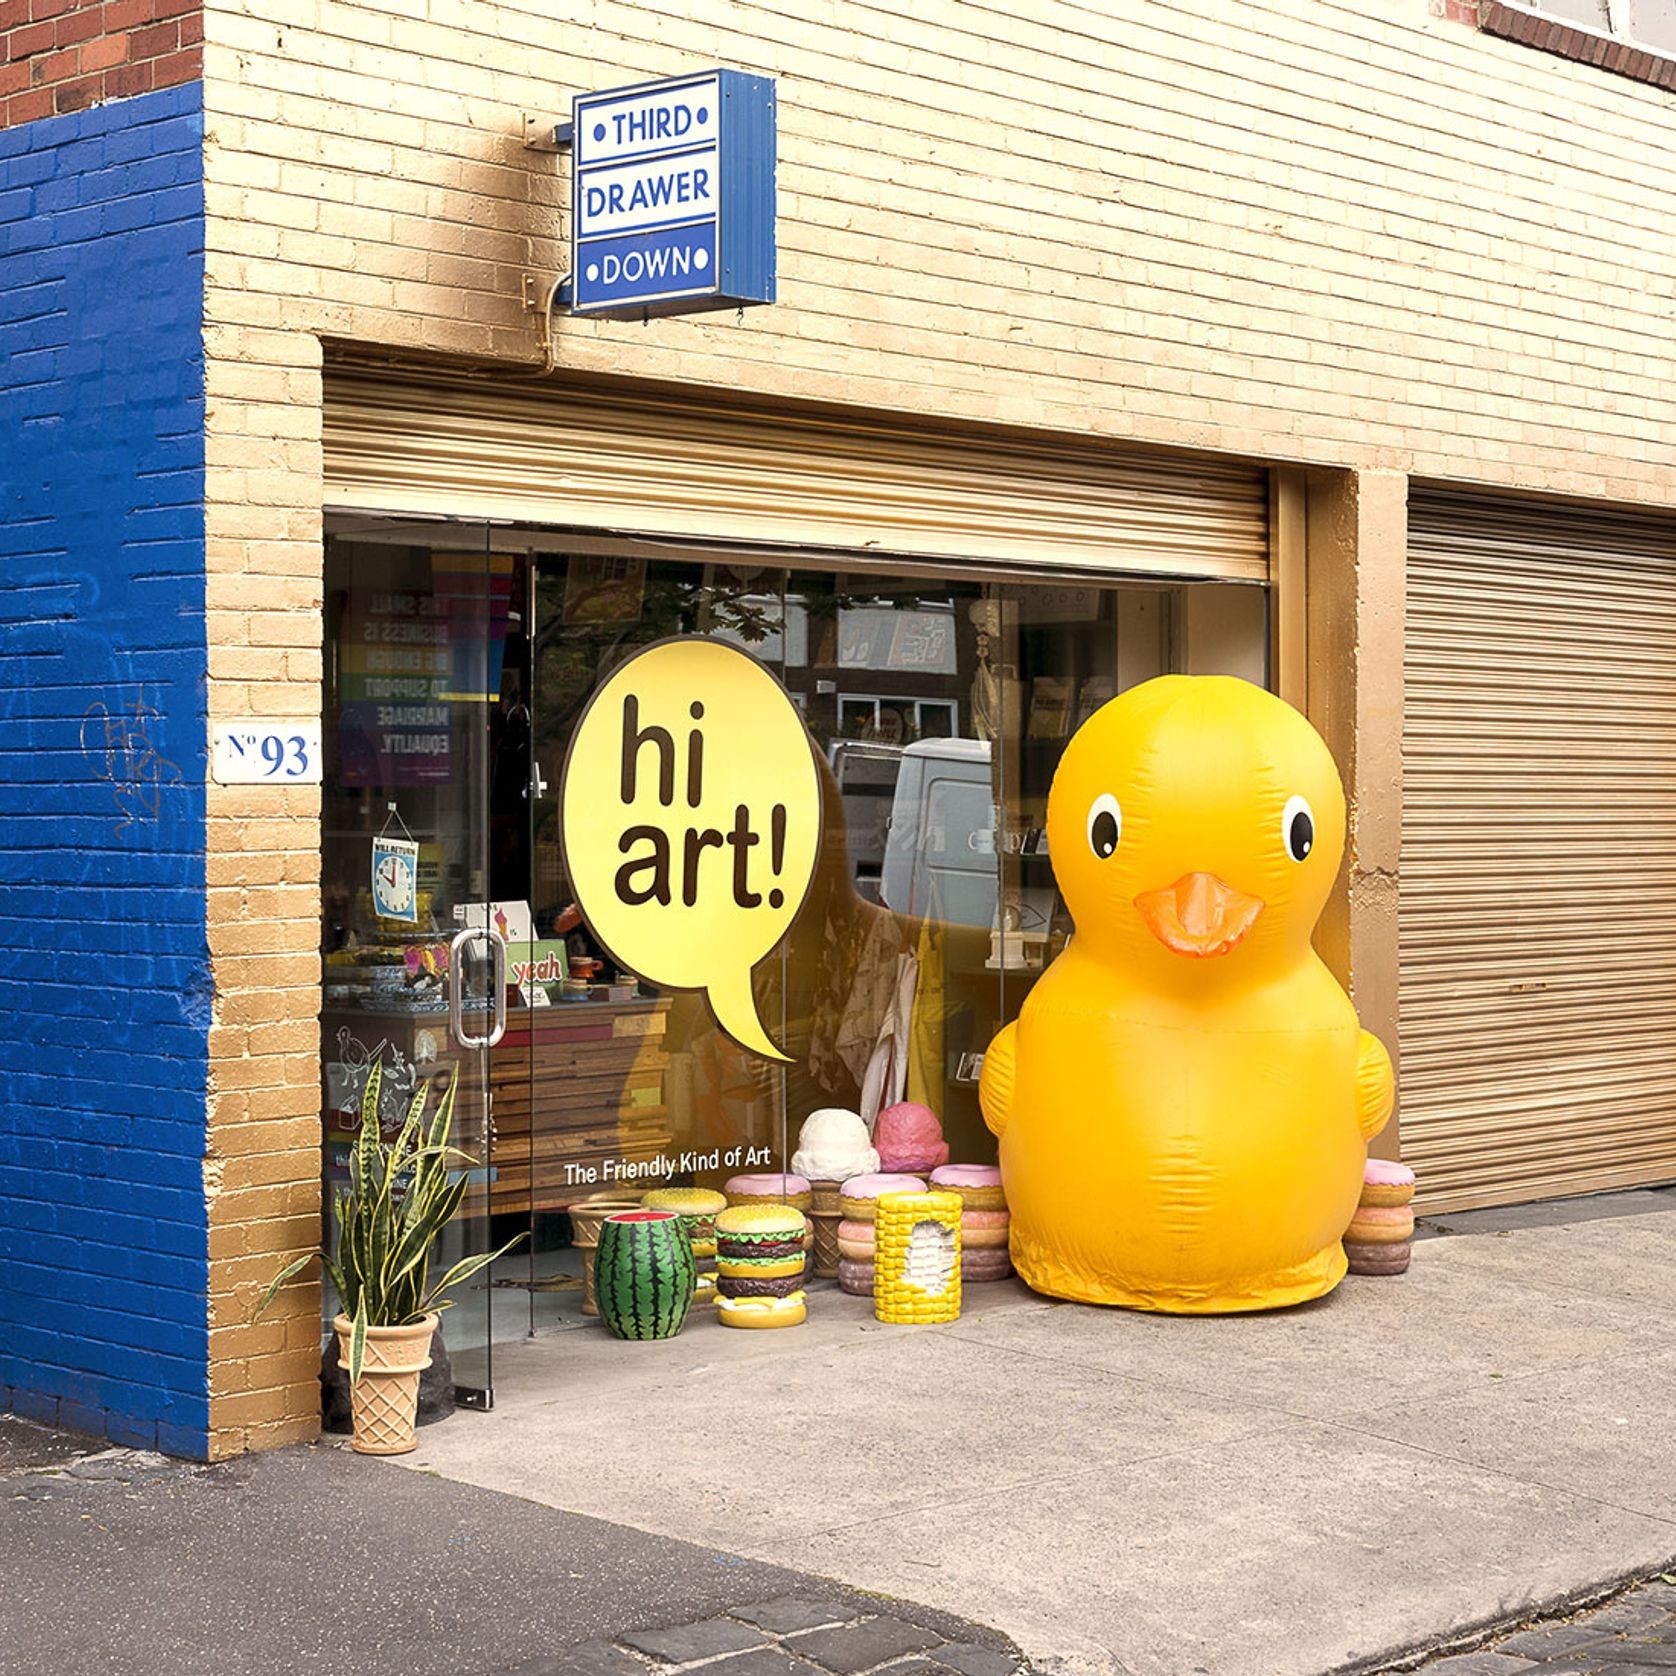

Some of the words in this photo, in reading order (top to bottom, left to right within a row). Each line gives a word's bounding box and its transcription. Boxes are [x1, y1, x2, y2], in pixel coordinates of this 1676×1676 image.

[612, 104, 692, 145] THIRD
[587, 168, 710, 217] DRAWER
[603, 246, 691, 285] DOWN
[620, 693, 705, 809] hi
[614, 803, 787, 910] art!
[512, 952, 561, 988] yeah
[564, 1163, 598, 1185] The
[602, 1155, 676, 1180] Friendly
[680, 1148, 719, 1174] Kind
[724, 1146, 742, 1167] of
[745, 1146, 771, 1166] Art
